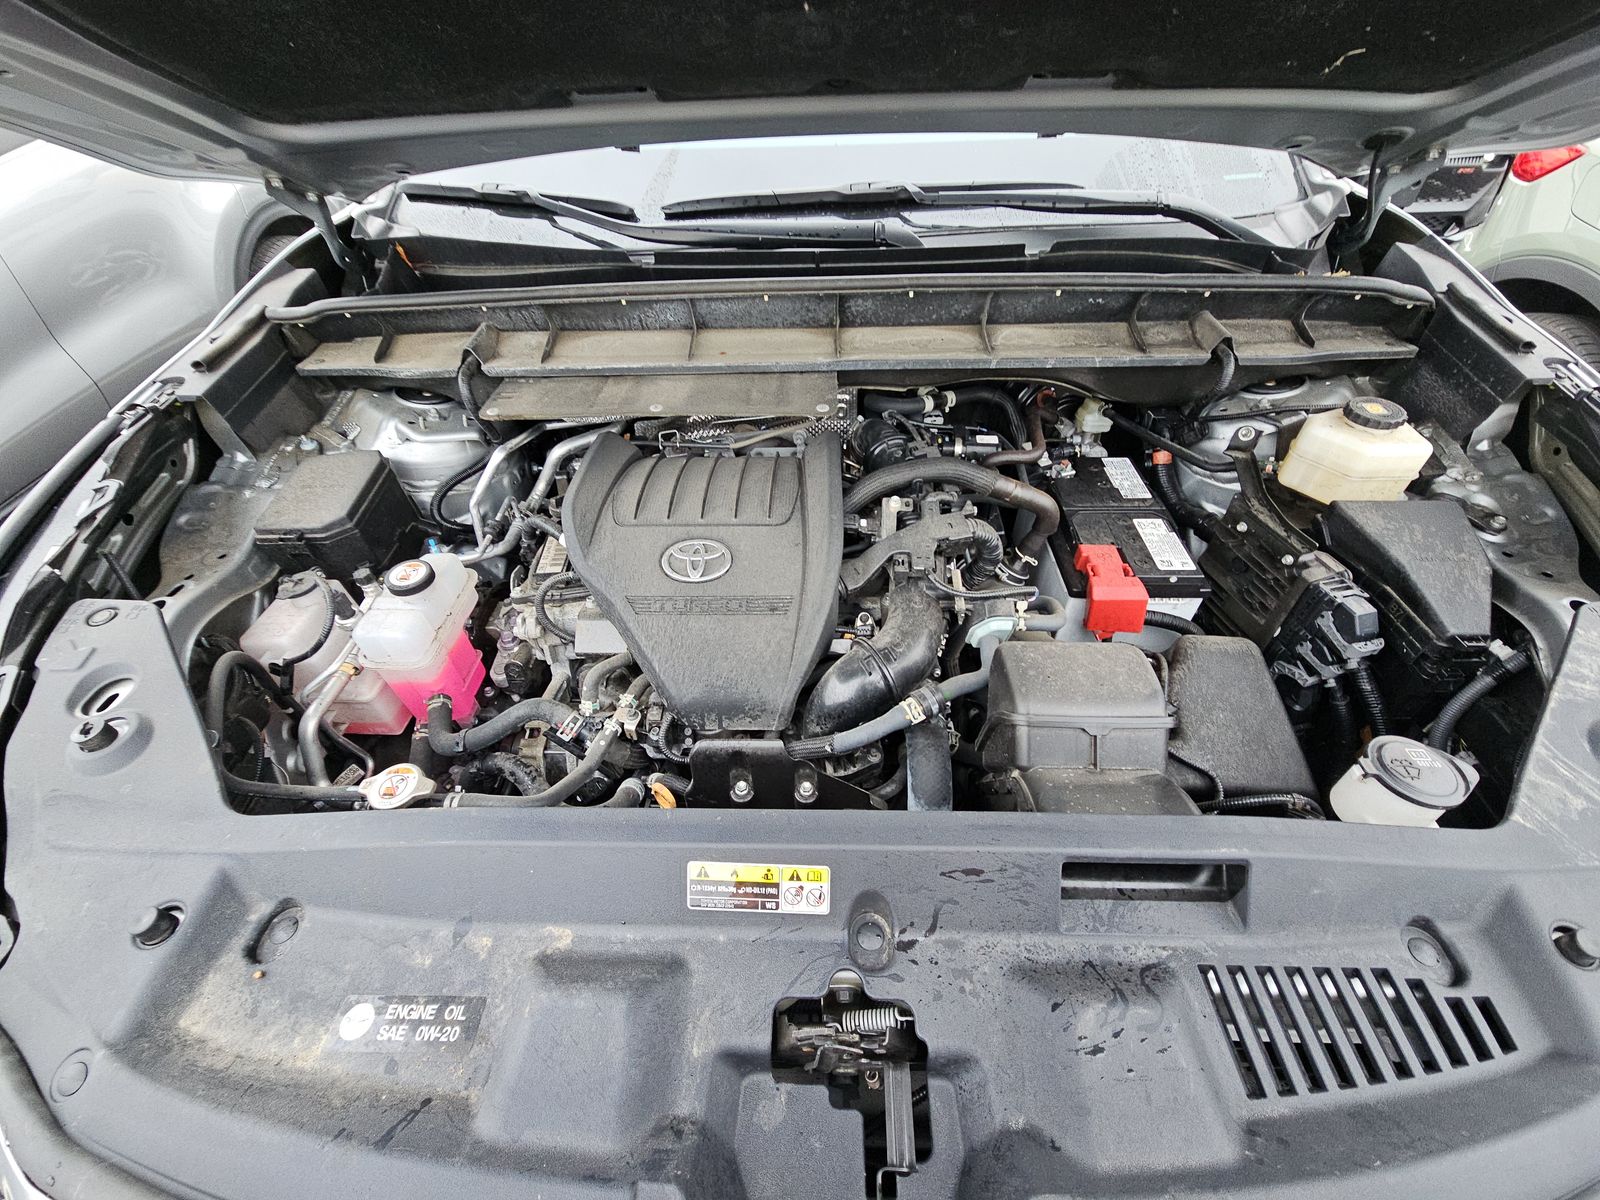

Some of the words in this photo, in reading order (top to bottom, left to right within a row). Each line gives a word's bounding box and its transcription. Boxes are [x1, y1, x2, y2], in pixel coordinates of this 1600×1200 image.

[384, 1004, 440, 1020] ENGINE
[444, 1005, 466, 1020] OIL
[376, 1025, 408, 1041] SAE
[415, 1026, 460, 1042] 0W-20
